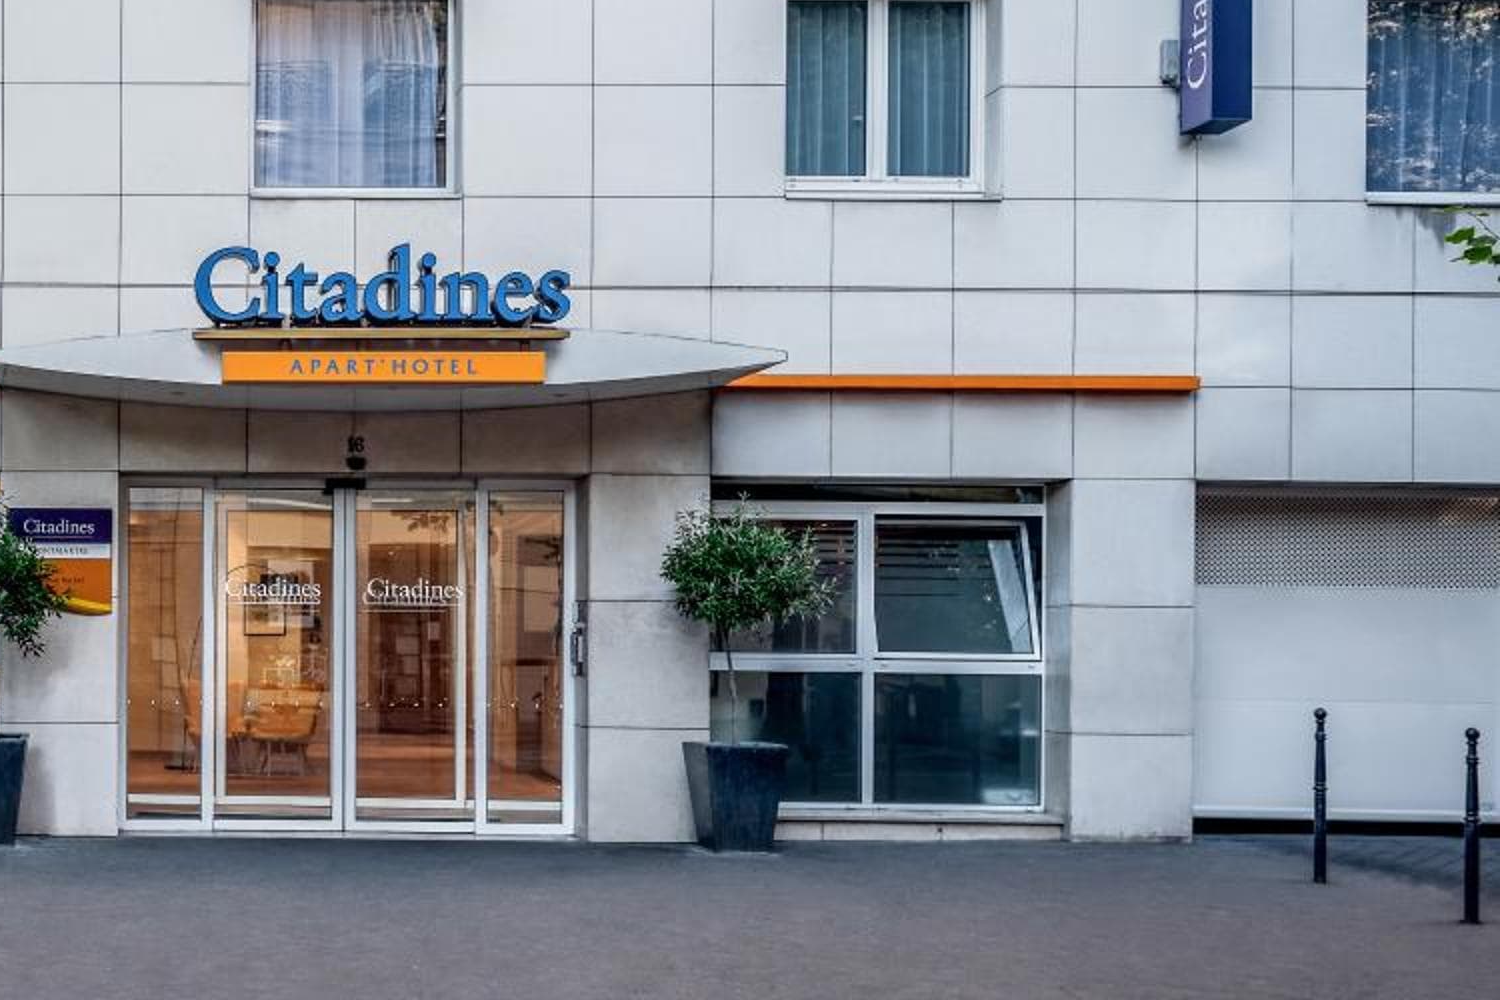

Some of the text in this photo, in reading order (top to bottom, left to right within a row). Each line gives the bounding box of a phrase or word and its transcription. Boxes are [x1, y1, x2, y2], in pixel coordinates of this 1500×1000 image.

[194, 242, 571, 327] Citadines
[290, 358, 478, 375] APART'HOTEL
[23, 518, 96, 535] Citadines
[226, 576, 321, 598] Citadines
[367, 577, 465, 601] Citadines
